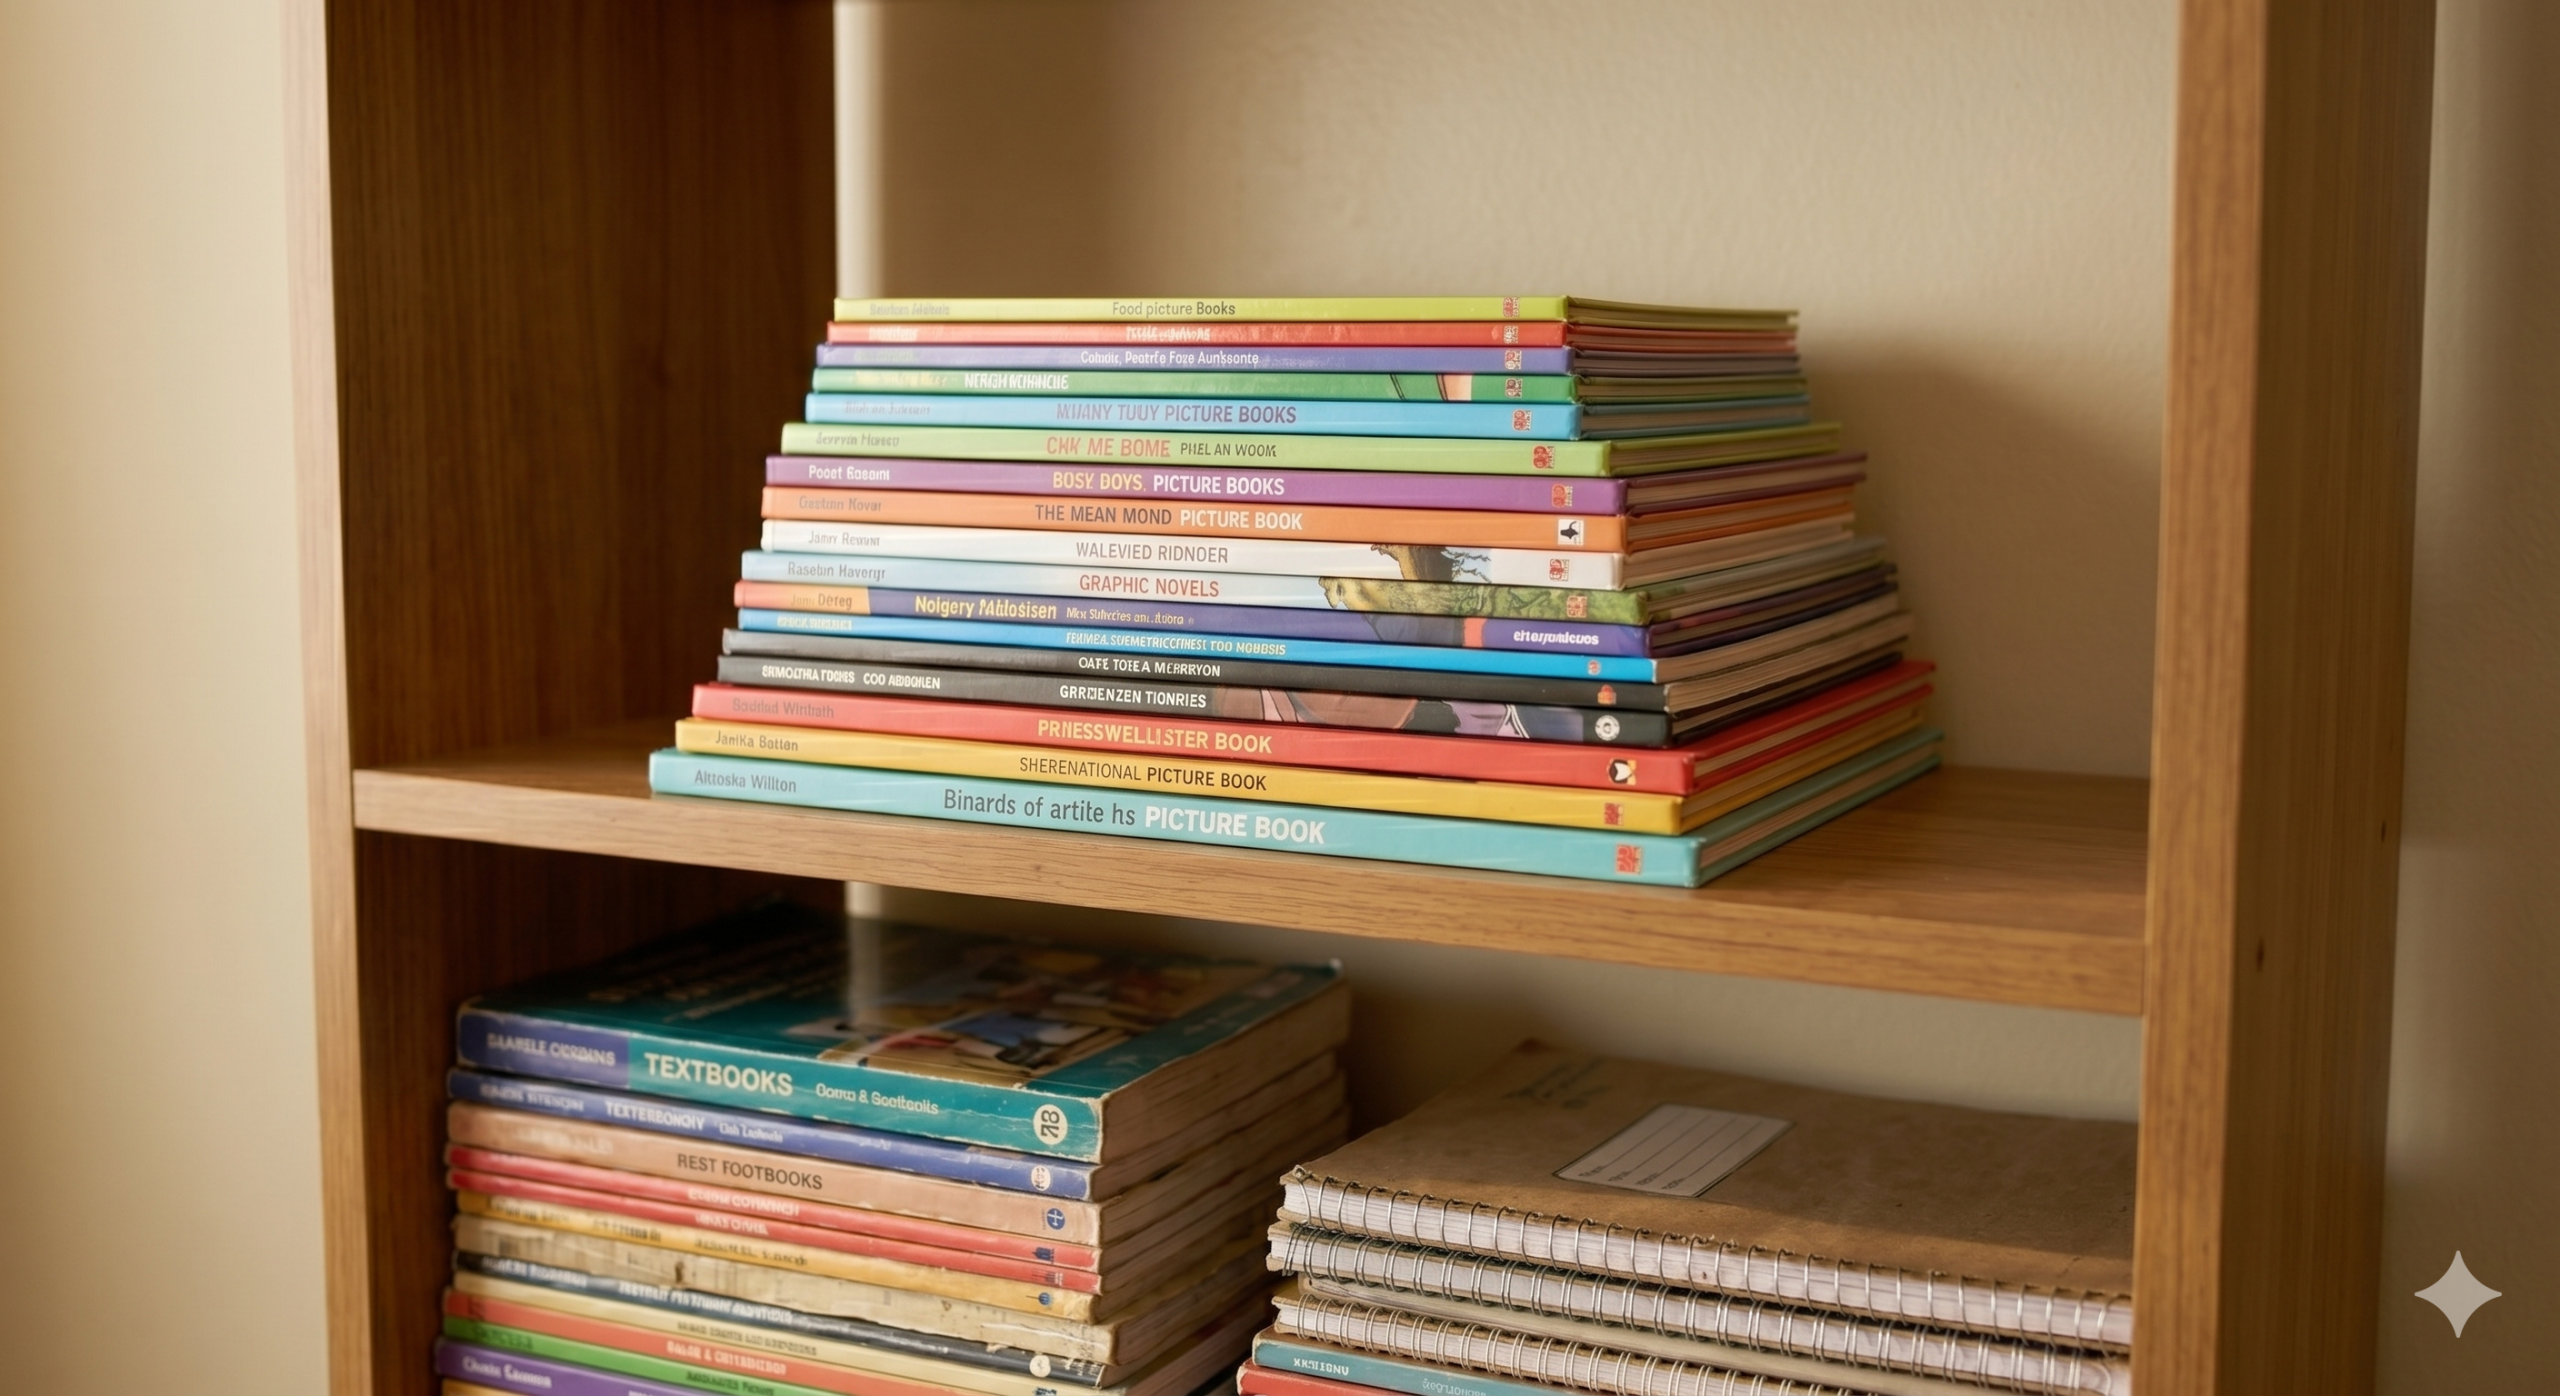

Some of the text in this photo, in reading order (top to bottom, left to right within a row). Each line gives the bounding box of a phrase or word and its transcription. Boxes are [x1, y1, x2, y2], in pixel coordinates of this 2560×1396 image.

[1112, 301, 1236, 319] Food picture Books
[1165, 405, 1233, 423] PICTURE
[1238, 406, 1298, 425] BOOKS
[1087, 438, 1115, 456] ME
[1120, 439, 1171, 458] BOME
[1153, 474, 1222, 494] PICTURE
[1226, 477, 1285, 496] BOOKS
[1035, 504, 1304, 531] THE MEAN MOND PICTURE BOOK
[1076, 541, 1152, 560] WALEVIED
[1079, 574, 1220, 597] GRAPHIC NOVELS
[1215, 732, 1273, 754] BOOK
[1020, 757, 1267, 791] SHERENATIONAL PICTURE BOOK
[944, 788, 1325, 845] Binards of artite hs PICTURE BOOK
[644, 1051, 793, 1097] TEXTBOOKS
[859, 1089, 869, 1104] &
[677, 1153, 823, 1190] REST FOOTBOOKS
